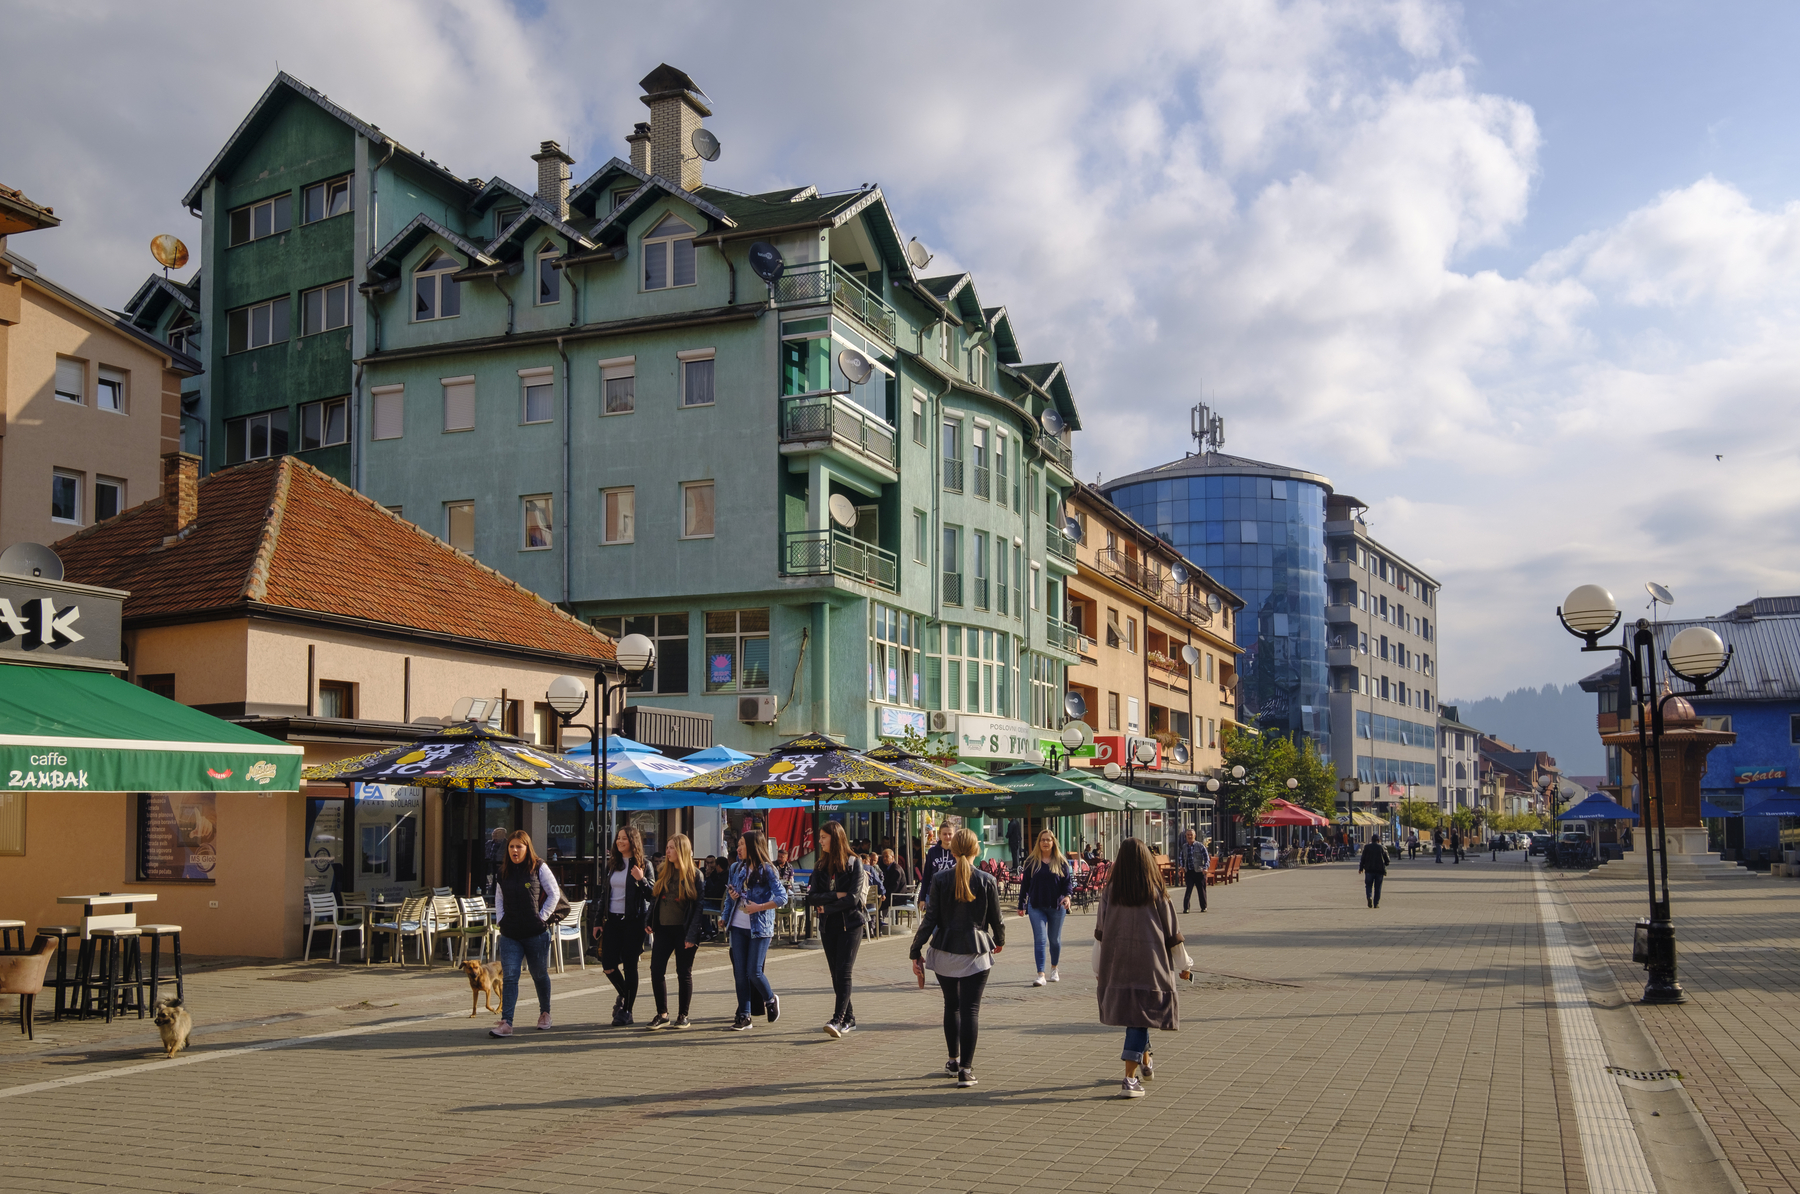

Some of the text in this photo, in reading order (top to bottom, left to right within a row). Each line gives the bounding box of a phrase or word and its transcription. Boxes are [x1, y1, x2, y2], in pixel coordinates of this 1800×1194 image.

[30, 752, 68, 766] caffe
[8, 769, 89, 790] ZAMBAK
[1739, 769, 1783, 784] Skala
[409, 787, 420, 797] ALU
[390, 799, 420, 808] STOLARIJA
